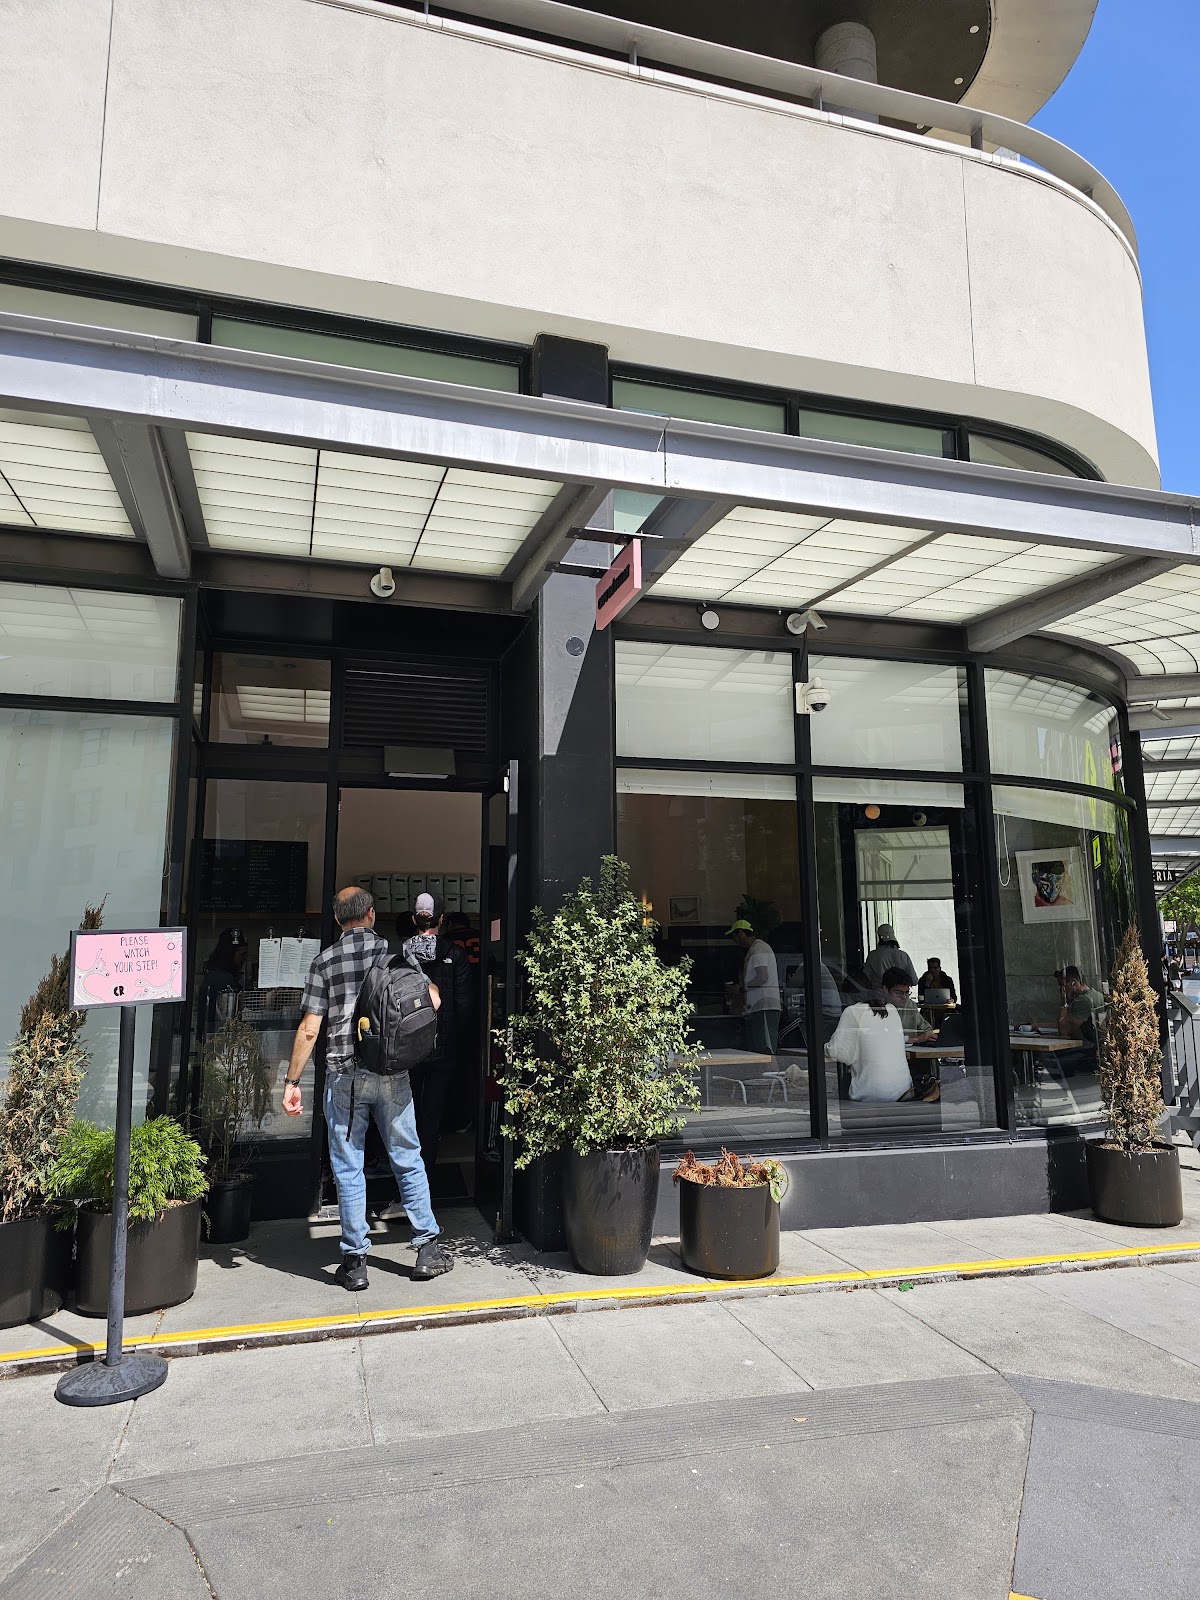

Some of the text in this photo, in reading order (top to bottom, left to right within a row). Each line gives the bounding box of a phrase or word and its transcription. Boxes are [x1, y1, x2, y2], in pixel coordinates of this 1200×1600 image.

[120, 936, 149, 946] PLEASE
[124, 948, 150, 958] WATCH
[114, 960, 158, 973] YOUR STEP!
[113, 985, 124, 997] CR
